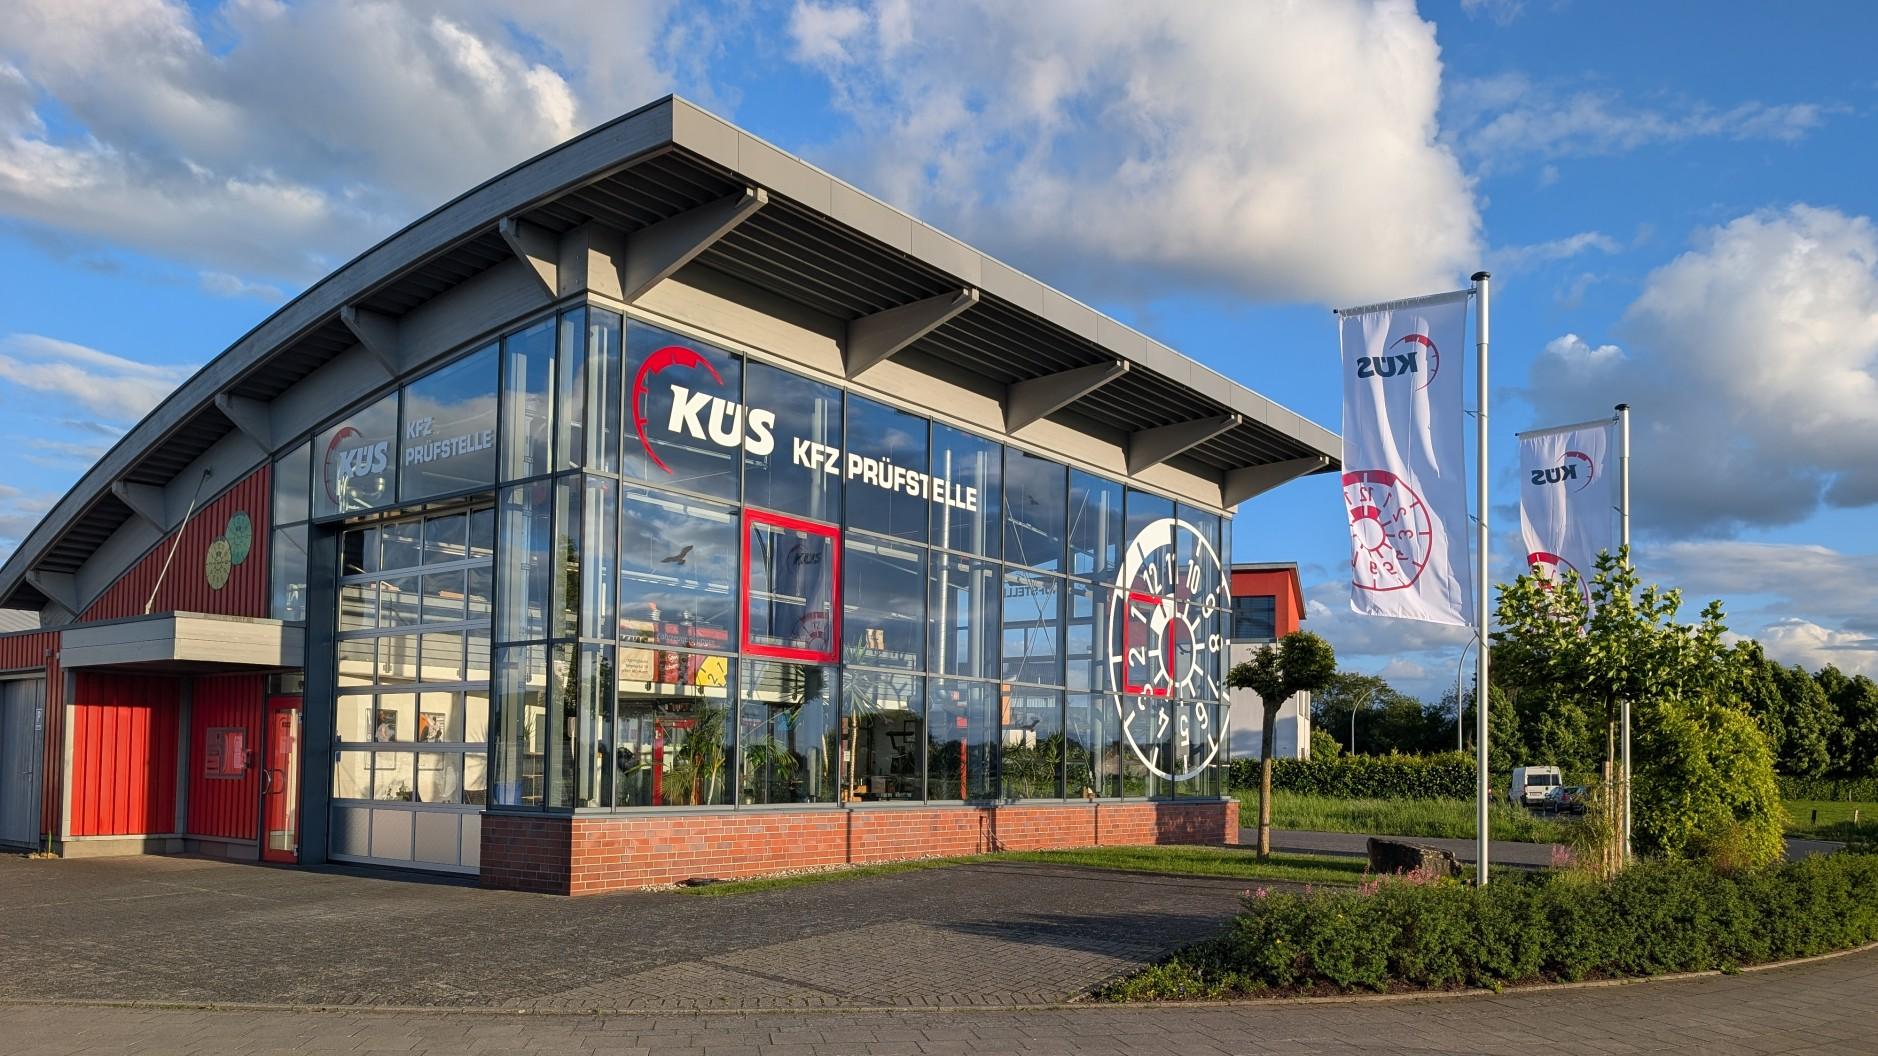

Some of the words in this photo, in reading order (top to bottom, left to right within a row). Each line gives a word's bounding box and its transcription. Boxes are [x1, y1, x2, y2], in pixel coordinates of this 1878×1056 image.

[406, 416, 434, 439] KFZ
[667, 384, 776, 456] KÜS
[336, 440, 389, 478] KÜS
[405, 429, 494, 466] PRÜFSTELLE
[792, 437, 841, 476] KFZ
[848, 454, 978, 512] PRÜFSTELLE
[1142, 562, 1163, 594] 12
[1165, 553, 1179, 585] 11
[1187, 559, 1201, 595] 10
[1130, 603, 1148, 624] 1
[1201, 593, 1216, 619] 9
[1128, 646, 1146, 667] 2
[1208, 634, 1223, 653] 8
[707, 673, 718, 685] 2
[716, 661, 724, 673] 1
[1137, 683, 1153, 711] 3
[1156, 707, 1170, 739] 4
[1195, 702, 1208, 730] 6
[1179, 717, 1190, 747] 5
